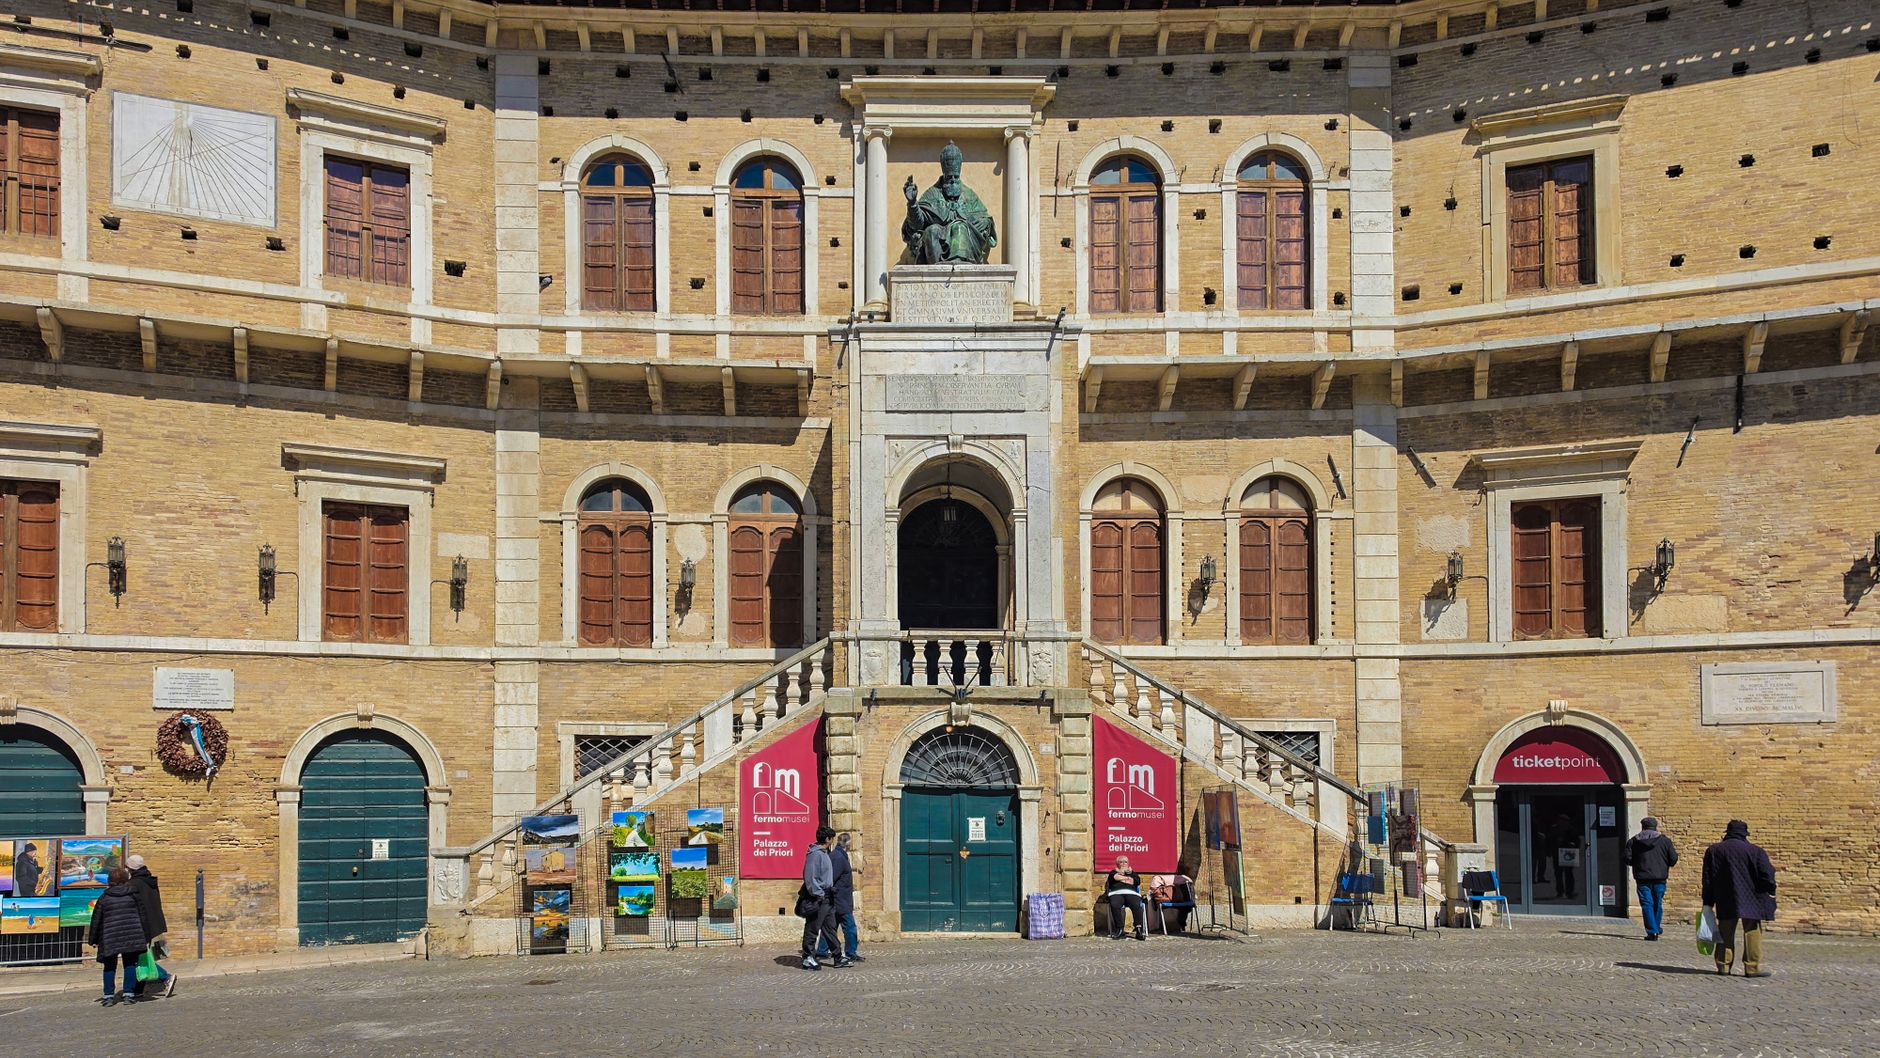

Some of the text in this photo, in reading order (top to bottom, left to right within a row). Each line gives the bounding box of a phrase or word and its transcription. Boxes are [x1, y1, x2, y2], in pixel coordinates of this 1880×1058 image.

[1512, 755, 1601, 770] ticketpoint
[753, 815, 810, 823] fermomusei
[1108, 811, 1165, 819] fermomusei
[1108, 834, 1143, 843] Palazzo
[753, 839, 788, 848] Palazzo
[1108, 843, 1149, 852] dei Priori
[753, 848, 794, 857] dei Priori
